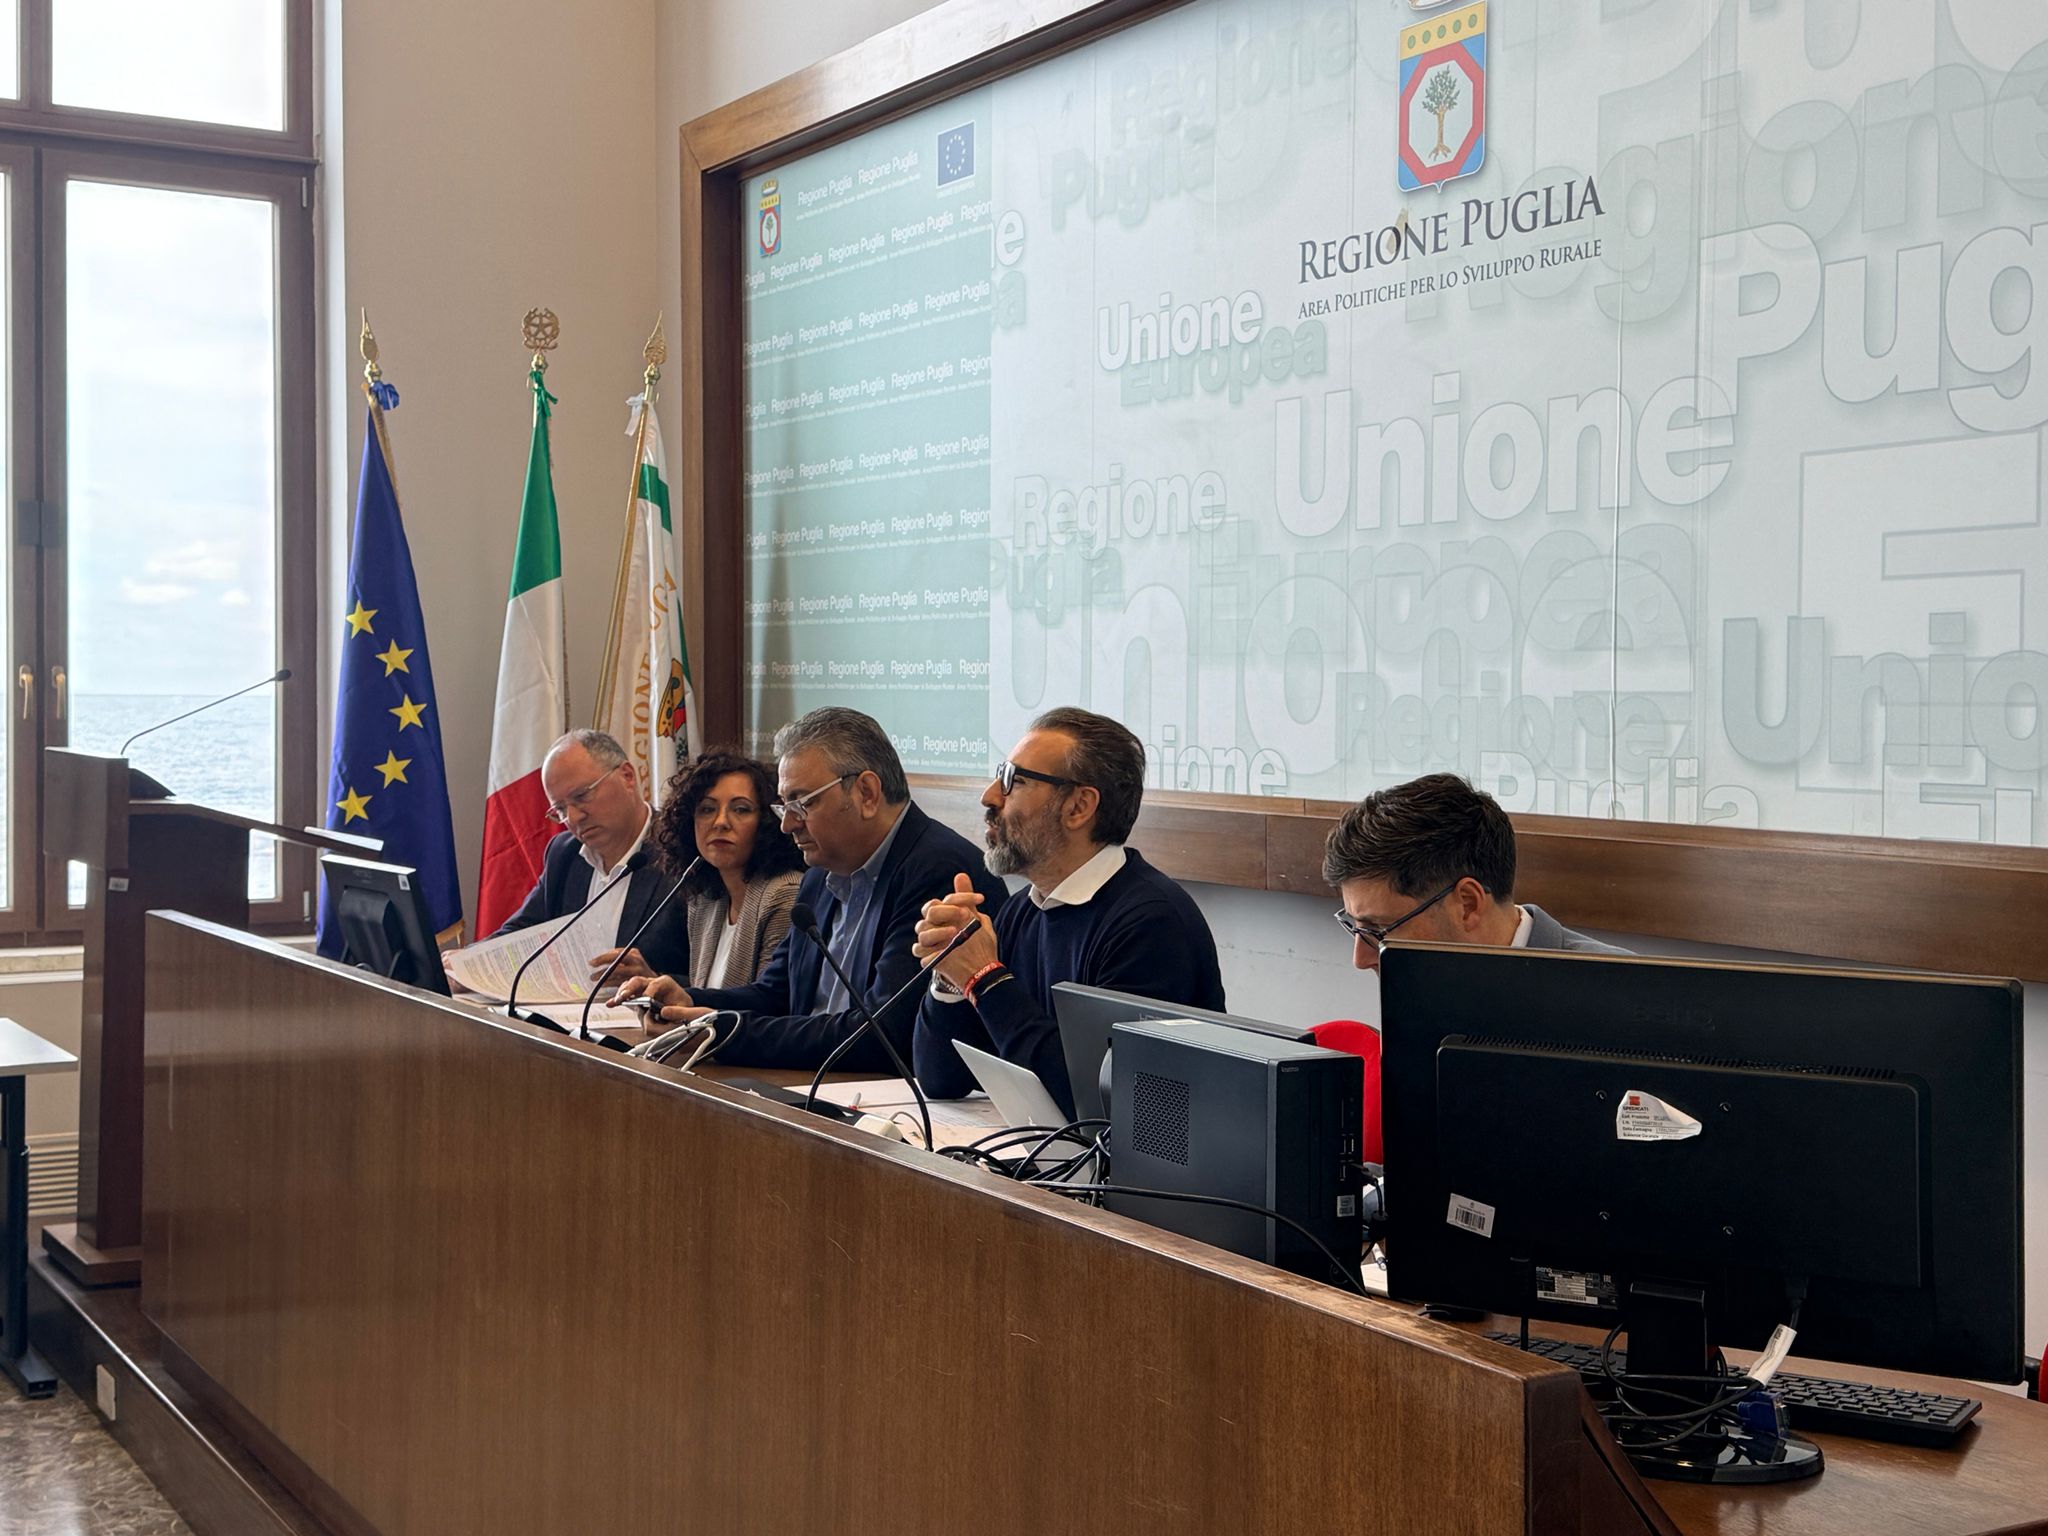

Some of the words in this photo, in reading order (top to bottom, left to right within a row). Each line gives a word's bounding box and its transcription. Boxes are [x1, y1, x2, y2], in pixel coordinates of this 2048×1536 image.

[829, 175, 853, 195] Puglia
[858, 164, 891, 185] Regione
[892, 151, 918, 172] Puglia
[800, 252, 822, 272] Puglia
[829, 243, 859, 263] Regione
[861, 232, 884, 254] Puglia
[892, 222, 925, 244] Regione
[927, 211, 953, 232] Puglia
[1298, 211, 1449, 284] REGIONE
[1461, 175, 1605, 247] PUGLIA
[1298, 301, 1331, 319] AREA
[1335, 282, 1406, 312] POLITICHE
[1410, 276, 1436, 295] PER
[1439, 271, 1458, 289] LO
[1462, 254, 1535, 286] SVILUPPO
[1539, 239, 1602, 269] RURALE
[830, 316, 852, 336] Puglia
[859, 307, 890, 328] Regione
[892, 299, 918, 320] Puglia
[925, 290, 960, 312] Regione
[962, 280, 990, 302] Puglia
[1098, 290, 1263, 372] Unione
[801, 390, 823, 408] Puglia
[829, 383, 859, 403] Regione
[861, 376, 885, 397] Puglia
[892, 370, 925, 390] Regione
[927, 361, 953, 383] Puglia
[800, 460, 829, 480] Regione
[830, 456, 853, 475] Puglia
[860, 450, 891, 471] Regione
[892, 445, 918, 466] Puglia
[925, 439, 960, 460] Regione
[961, 433, 989, 455] Puglia
[1274, 370, 1735, 537] Unione
[801, 525, 823, 544] Puglia
[829, 522, 859, 541] Regione
[861, 518, 885, 538] Puglia
[891, 515, 925, 535] Regione
[926, 511, 952, 531] Puglia
[1013, 463, 1226, 563] Regione
[800, 596, 829, 615] Regione
[830, 594, 853, 613] Puglia
[859, 592, 890, 611] Regione
[892, 590, 918, 610] Puglia
[924, 589, 959, 608] Regione
[961, 586, 988, 607] Puglia
[801, 661, 823, 679] Puglia
[829, 660, 859, 679] Regione
[860, 660, 885, 679] Puglia
[891, 659, 925, 679] Regione
[926, 659, 952, 679] Puglia
[923, 735, 958, 756] Regione
[960, 736, 988, 758] Puglia
